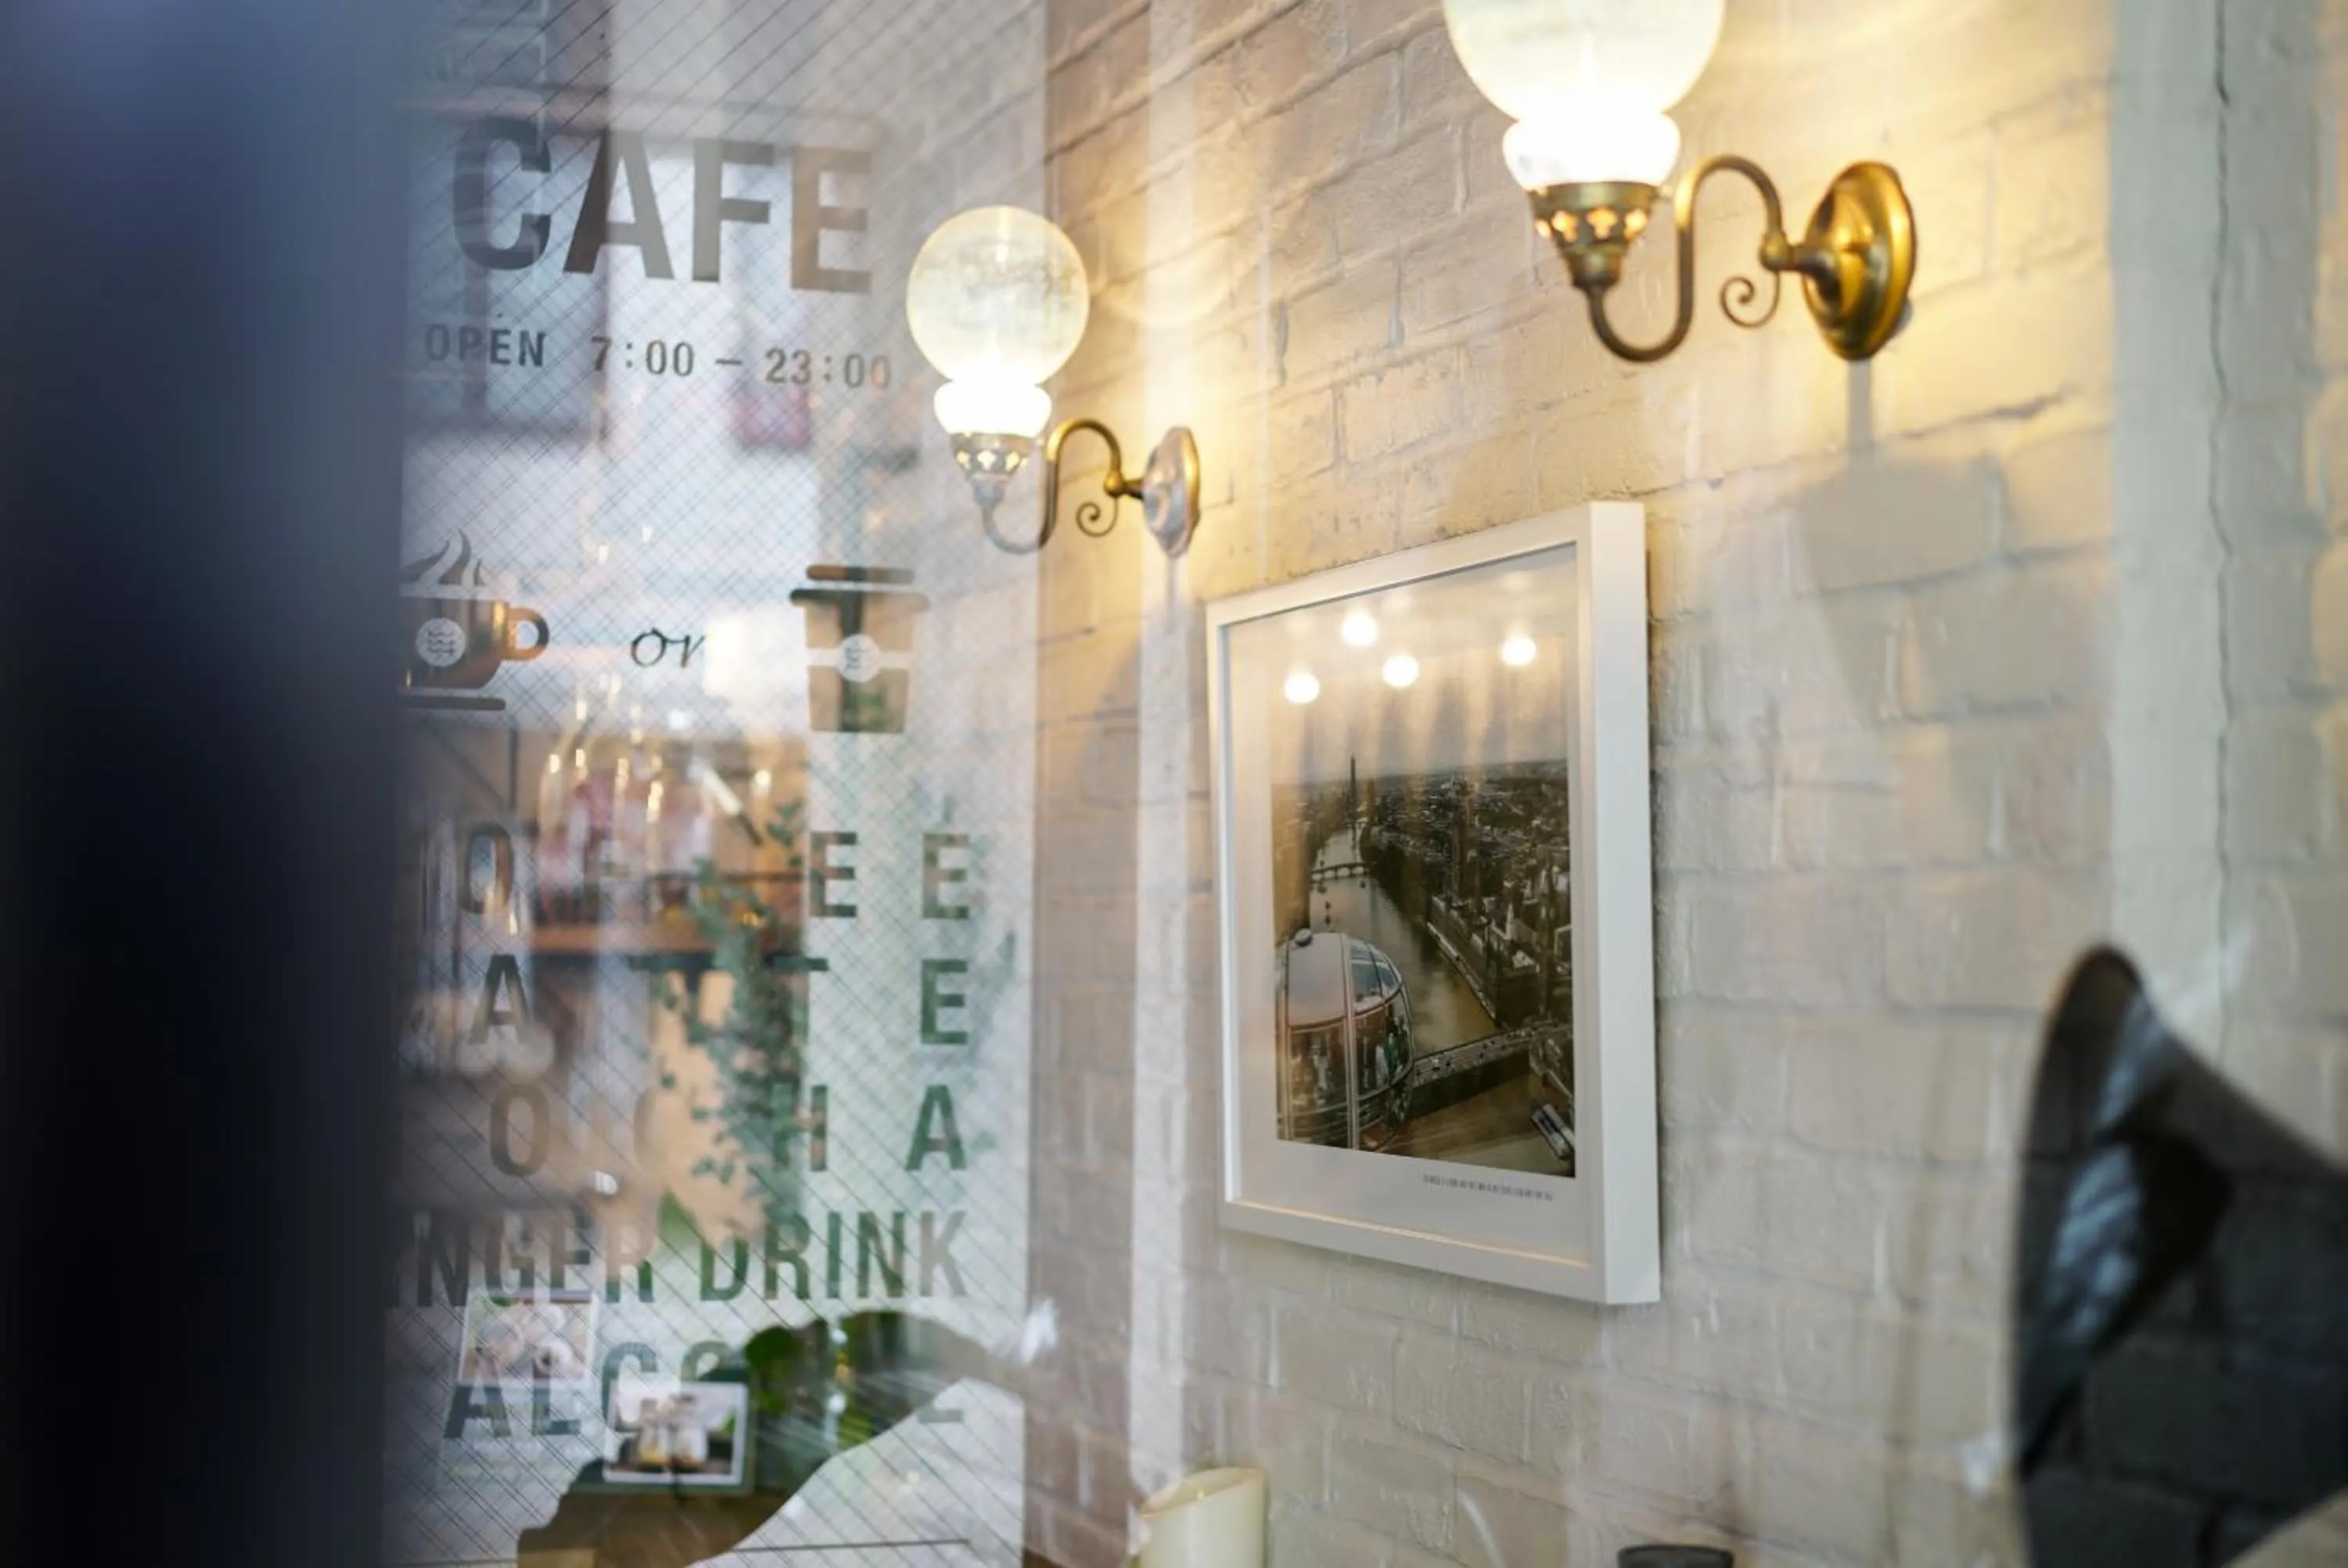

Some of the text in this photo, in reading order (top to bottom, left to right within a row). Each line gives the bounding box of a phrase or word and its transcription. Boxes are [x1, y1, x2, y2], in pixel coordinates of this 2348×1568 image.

[452, 117, 874, 295] CAFE
[424, 322, 547, 368] OPEN
[590, 335, 696, 378] 7:00
[765, 347, 893, 390] 23:00
[630, 626, 708, 669] or
[700, 1210, 968, 1301] DRINK
